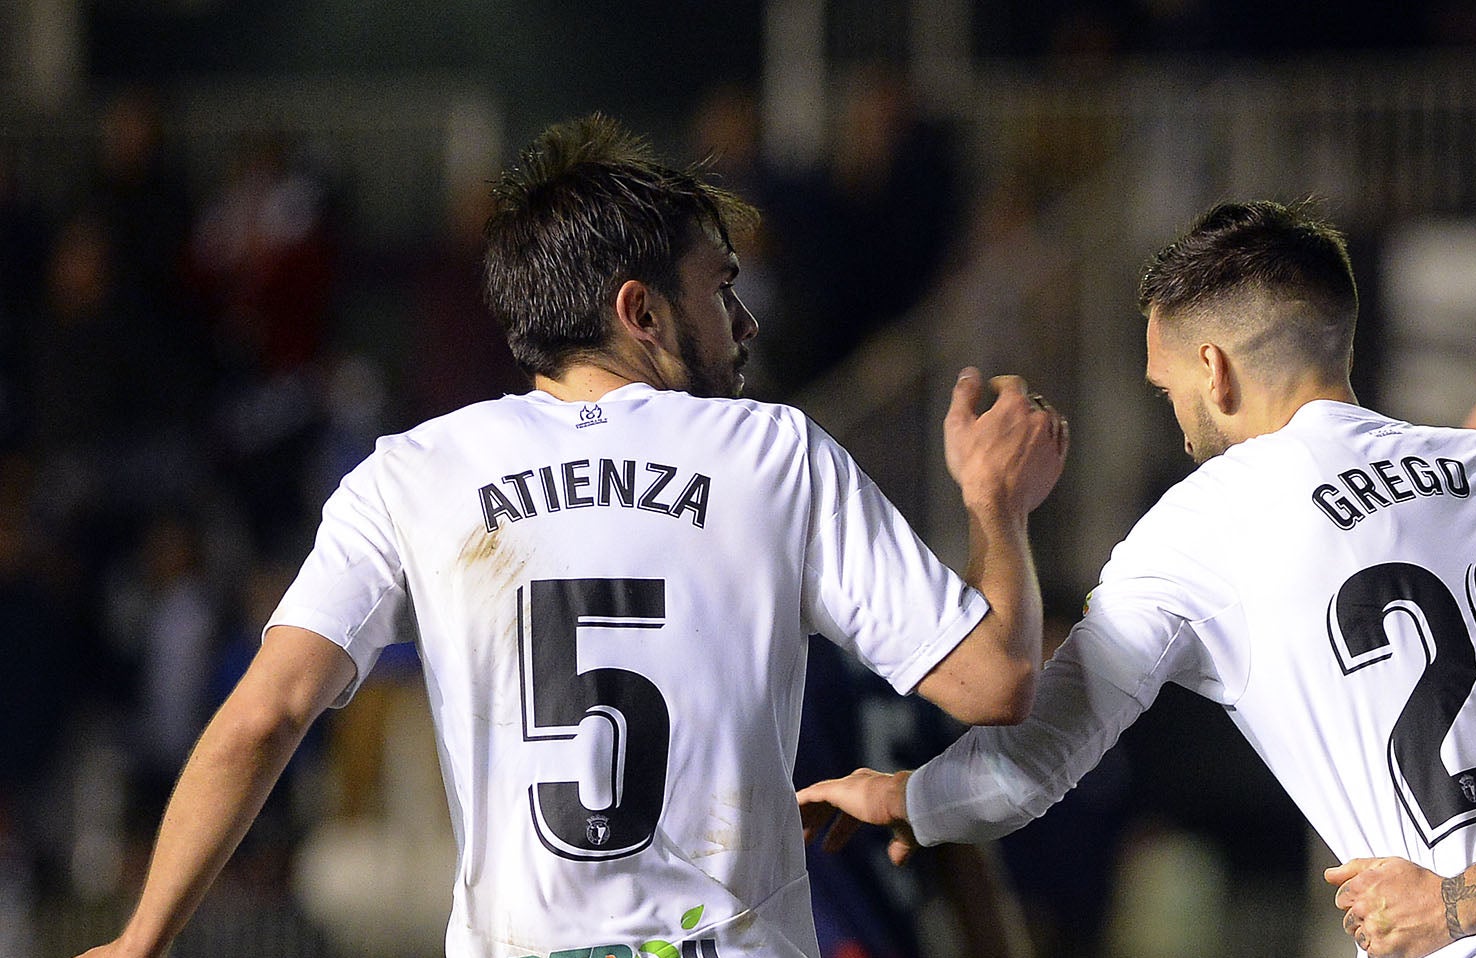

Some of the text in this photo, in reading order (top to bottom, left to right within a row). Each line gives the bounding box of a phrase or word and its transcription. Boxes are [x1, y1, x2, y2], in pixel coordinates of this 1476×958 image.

[477, 458, 712, 533] ATIENZA
[1312, 455, 1471, 531] GREGO
[516, 576, 671, 863] 5
